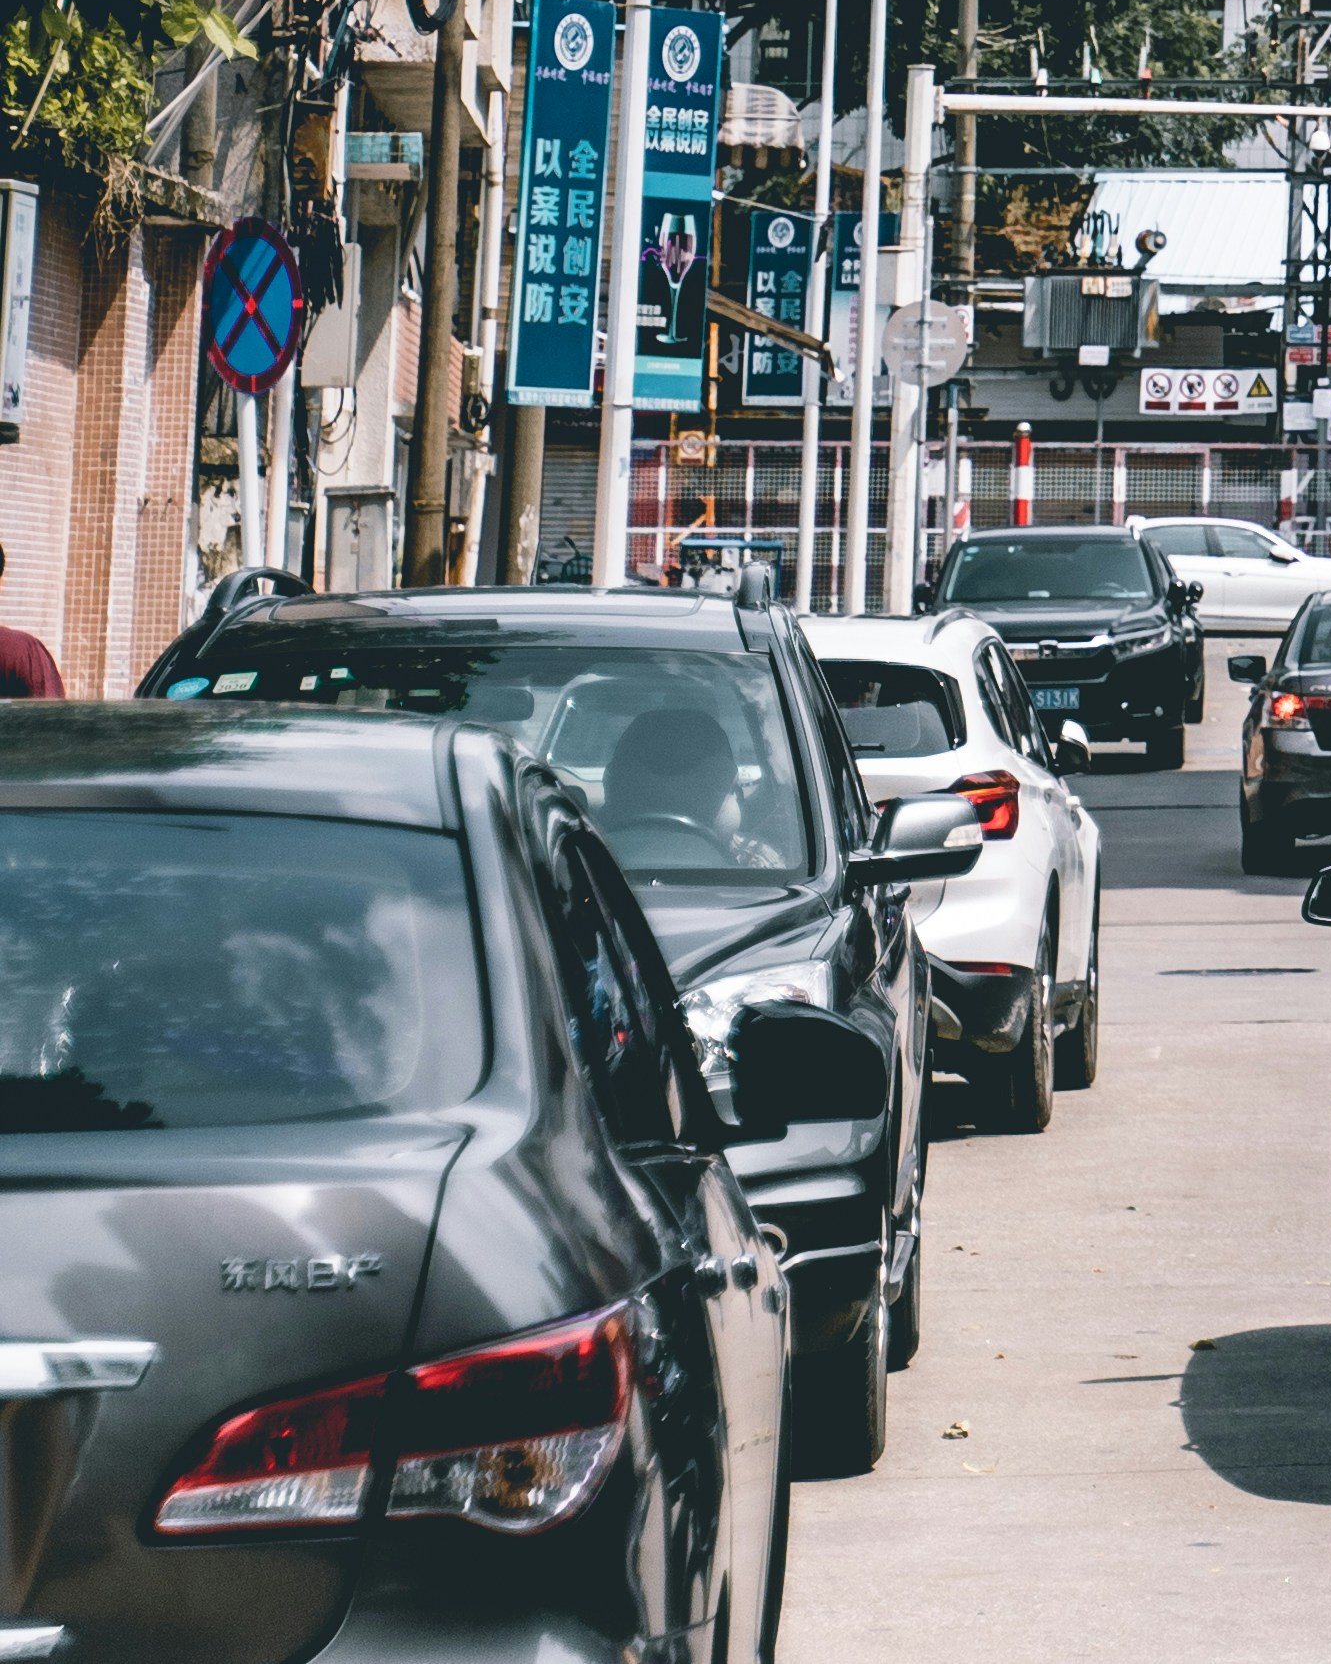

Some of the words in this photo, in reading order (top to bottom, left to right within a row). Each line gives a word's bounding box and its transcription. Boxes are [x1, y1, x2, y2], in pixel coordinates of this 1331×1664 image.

[645, 105, 709, 133] 全民创安
[645, 130, 708, 155] 以案说防
[523, 137, 563, 324] 以案说防
[558, 139, 599, 326] 全民创安
[776, 270, 803, 375] 全民安
[221, 1248, 383, 1292] 东风日产
